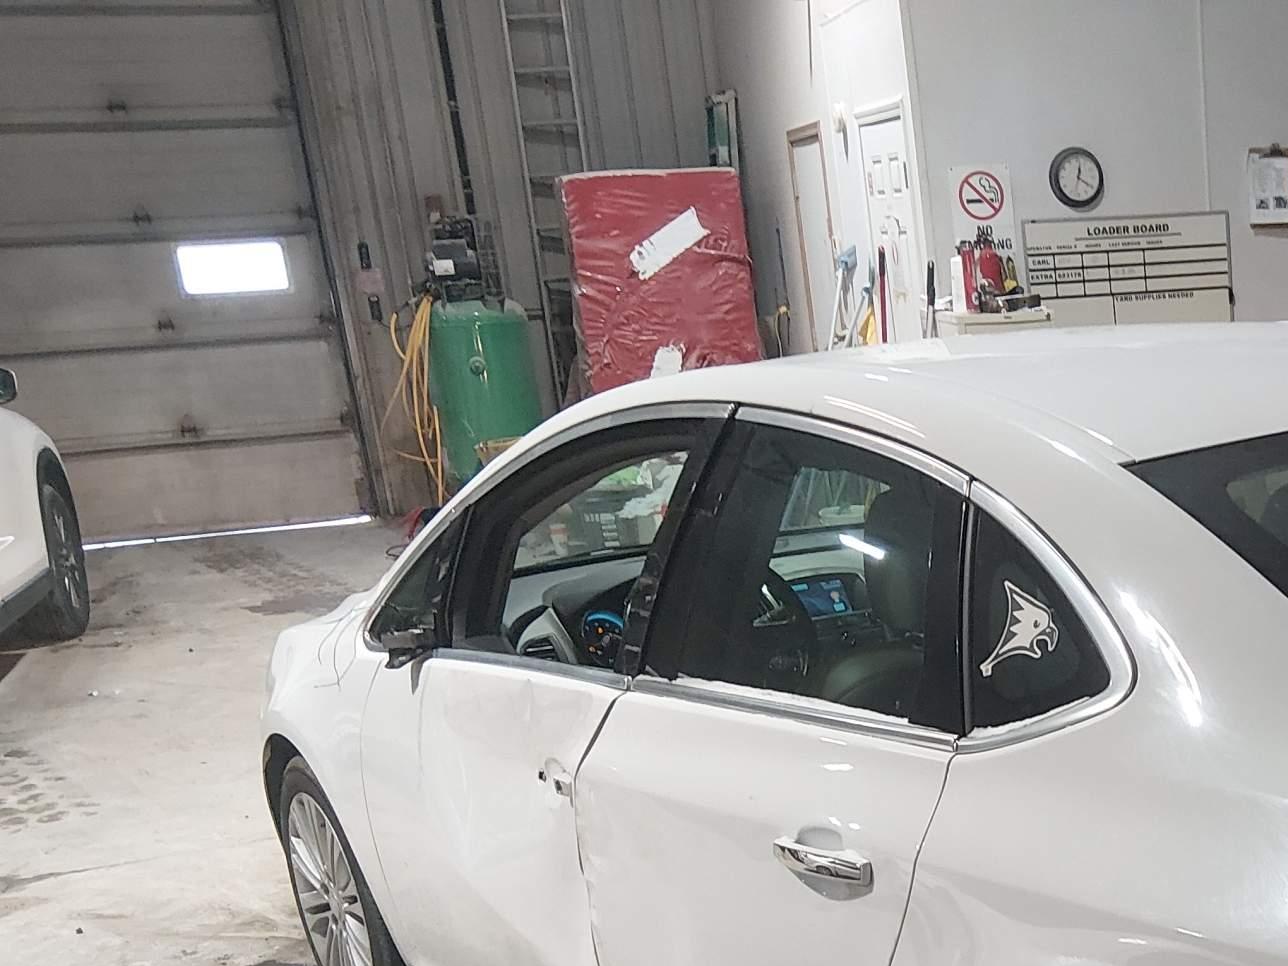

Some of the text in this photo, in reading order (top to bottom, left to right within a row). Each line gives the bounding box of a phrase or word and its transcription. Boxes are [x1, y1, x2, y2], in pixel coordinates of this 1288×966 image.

[976, 225, 993, 237] NO
[1087, 223, 1170, 236] LOADER BOARD
[1030, 273, 1054, 281] EXTRA
[1168, 291, 1194, 299] NEEDED
